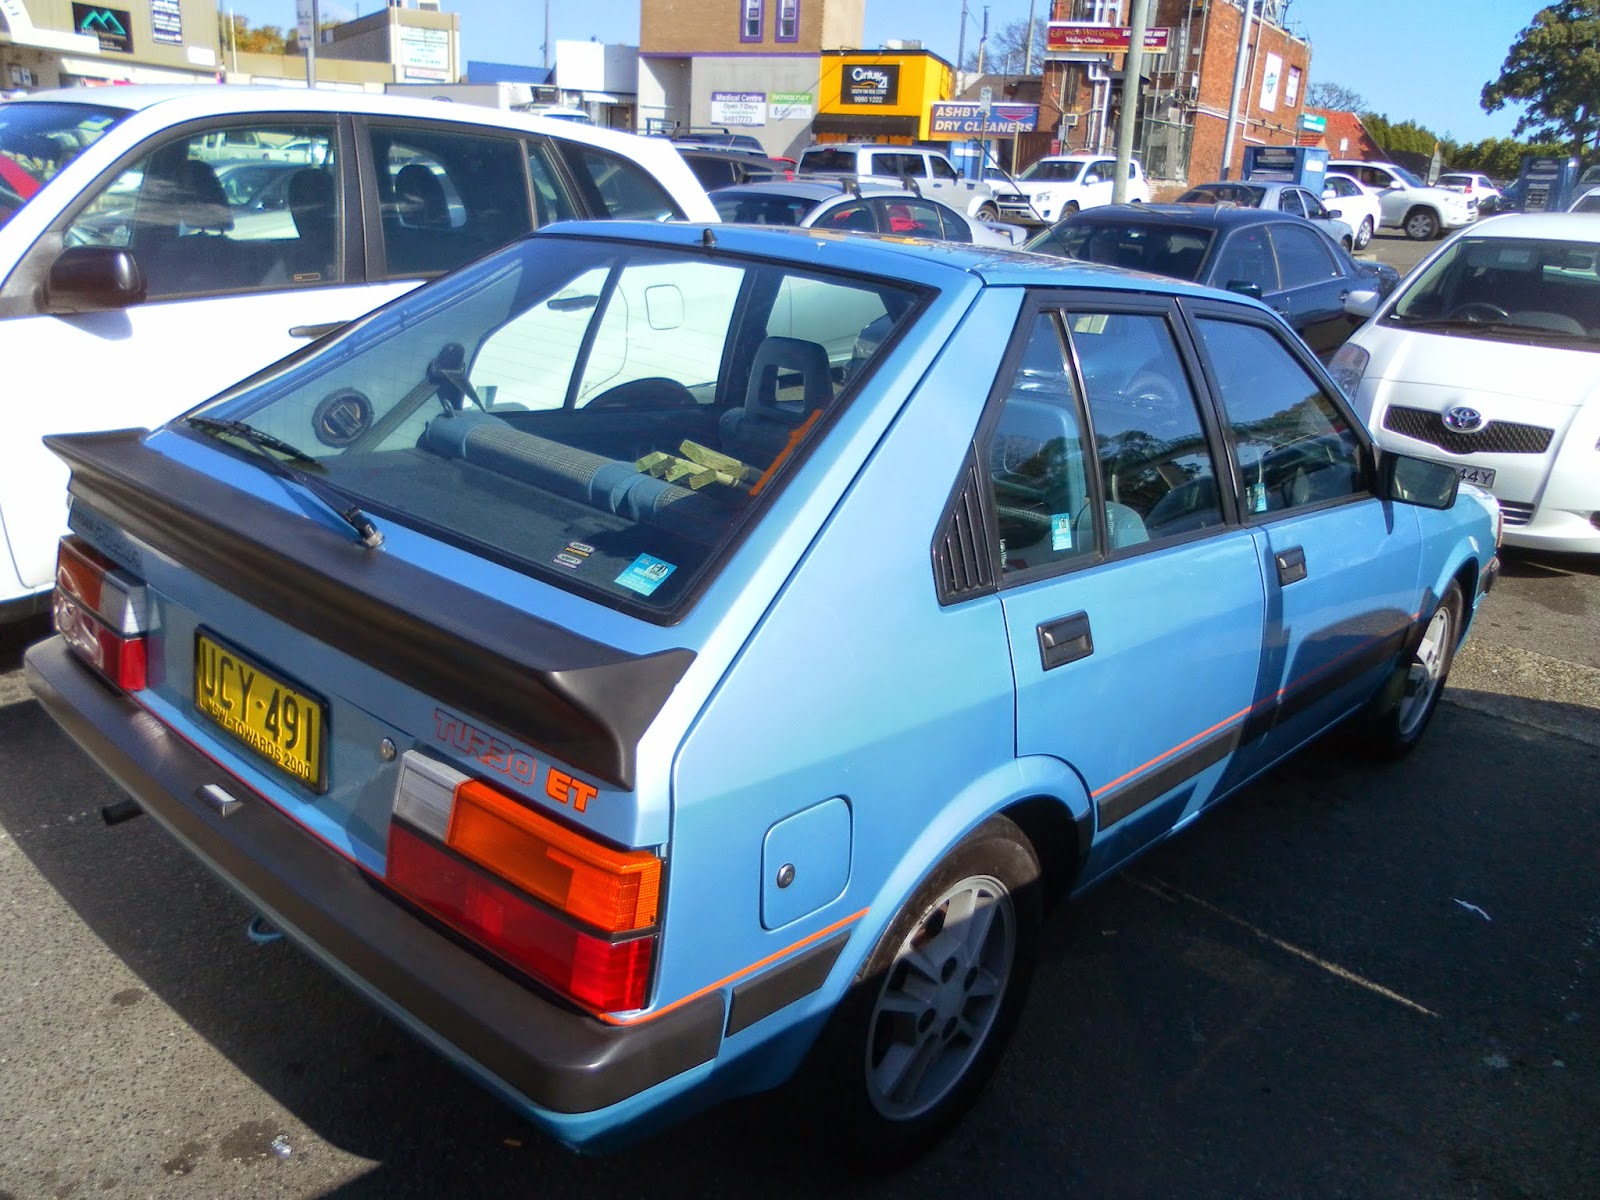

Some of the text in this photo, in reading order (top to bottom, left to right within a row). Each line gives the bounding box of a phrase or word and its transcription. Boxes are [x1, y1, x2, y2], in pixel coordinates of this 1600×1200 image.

[716, 94, 763, 102] Medical Centre
[772, 94, 810, 102] PATHOLOGY
[723, 102, 738, 110] Open
[744, 103, 758, 111] Days
[934, 120, 1034, 133] DRY CLEANERS
[283, 752, 312, 780] 2000
[432, 706, 600, 815] TURBO ET
